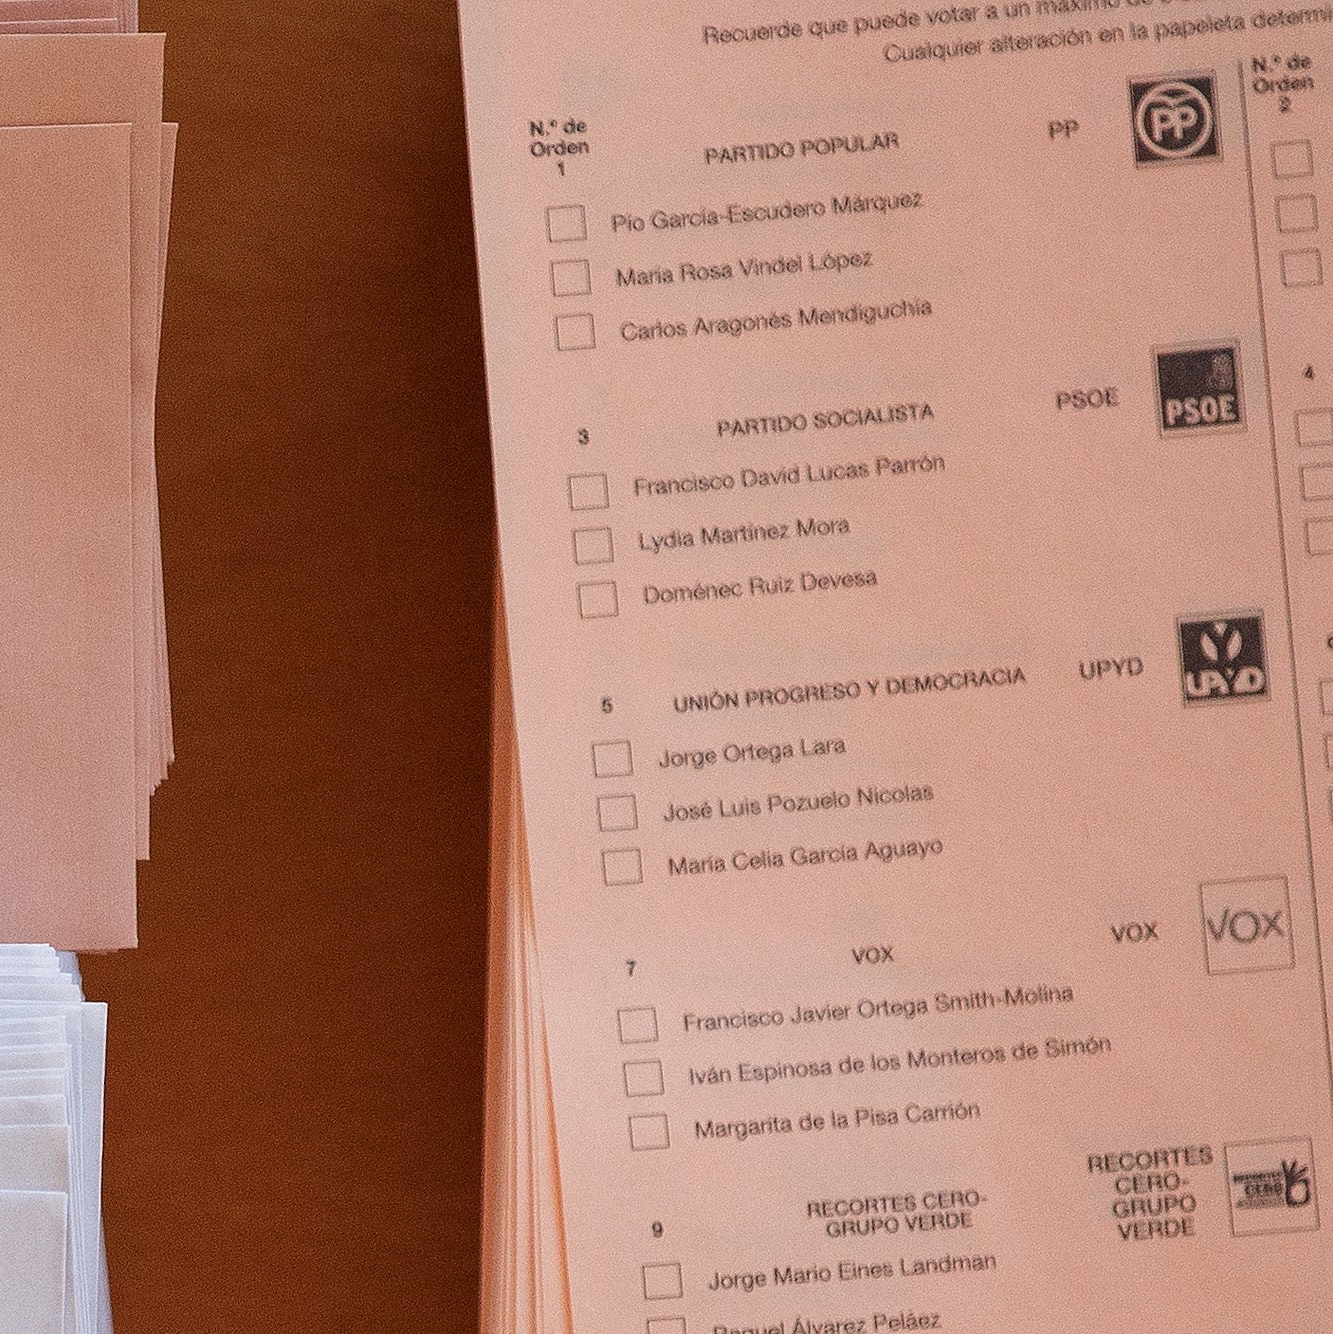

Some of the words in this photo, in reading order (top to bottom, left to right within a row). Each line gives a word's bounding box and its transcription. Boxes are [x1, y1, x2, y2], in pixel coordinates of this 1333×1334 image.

[1046, 118, 1080, 141] PP
[703, 140, 796, 165] PARTIDO
[799, 131, 900, 157] POPULAR
[1054, 386, 1119, 411] PSOE
[1165, 393, 1237, 426] PSOE
[716, 413, 808, 437] PARTIDO
[812, 402, 935, 430] SOCIALISTA
[1077, 655, 1145, 682] UPYD
[743, 680, 862, 707] PROGRESO
[865, 680, 880, 696] Y
[884, 665, 1027, 697] DEMOCRACIA
[1109, 921, 1159, 945] VOX
[1206, 909, 1285, 944] VOX
[850, 945, 895, 966] VOX
